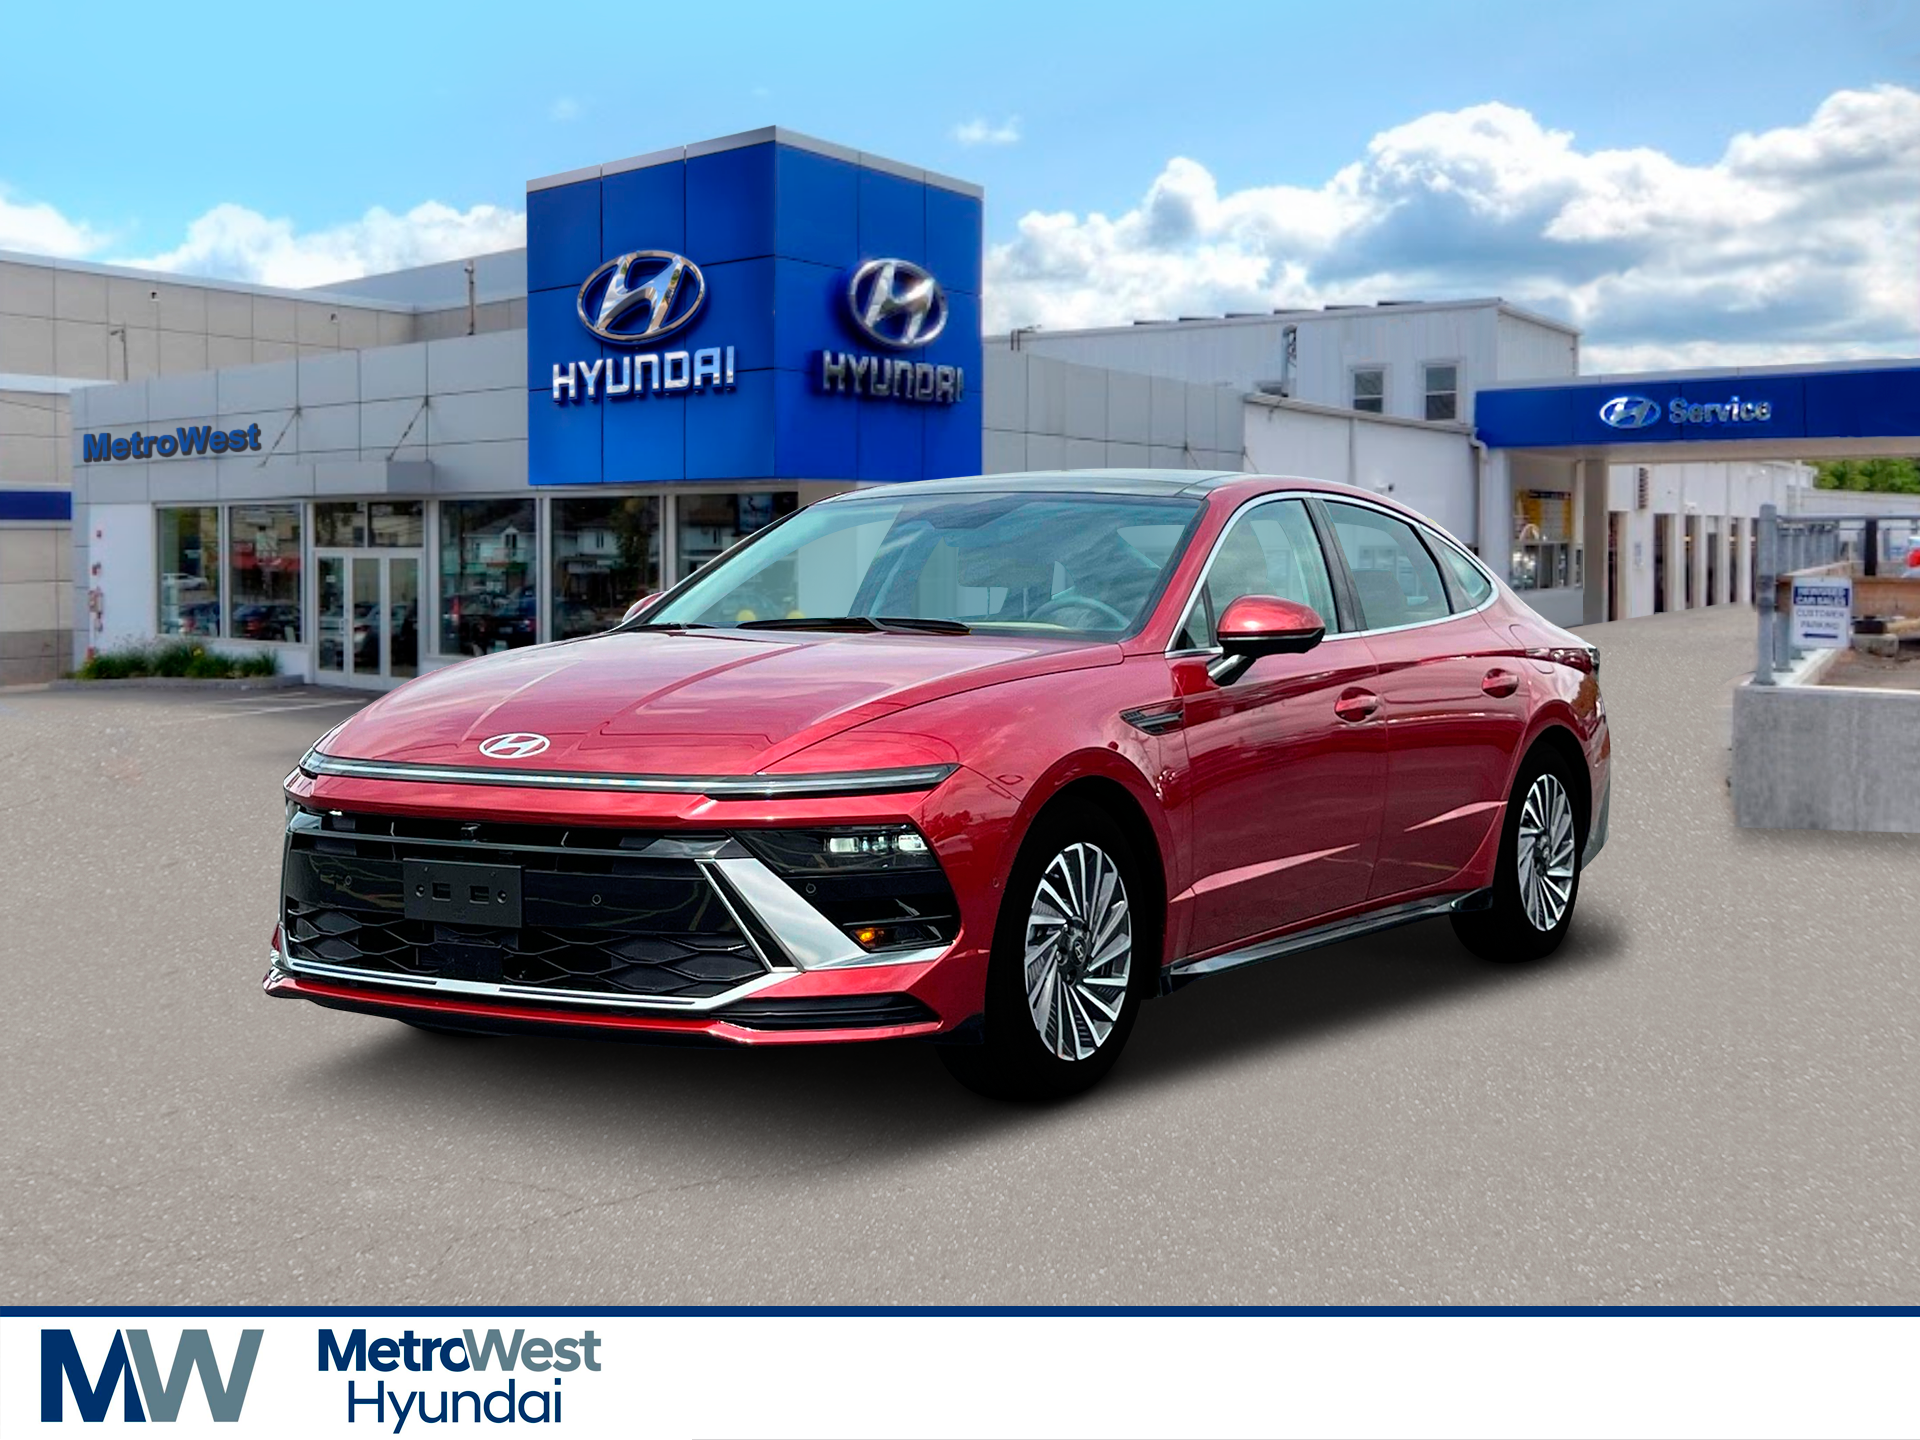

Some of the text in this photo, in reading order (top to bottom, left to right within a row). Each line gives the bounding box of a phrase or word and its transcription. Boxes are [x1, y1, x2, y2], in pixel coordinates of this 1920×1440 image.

[552, 346, 736, 402] HYUNDAI
[822, 350, 964, 403] HYUNDAI
[1668, 396, 1772, 425] Service
[83, 422, 262, 463] MetroWest
[1796, 609, 1845, 618] CUSTOMER
